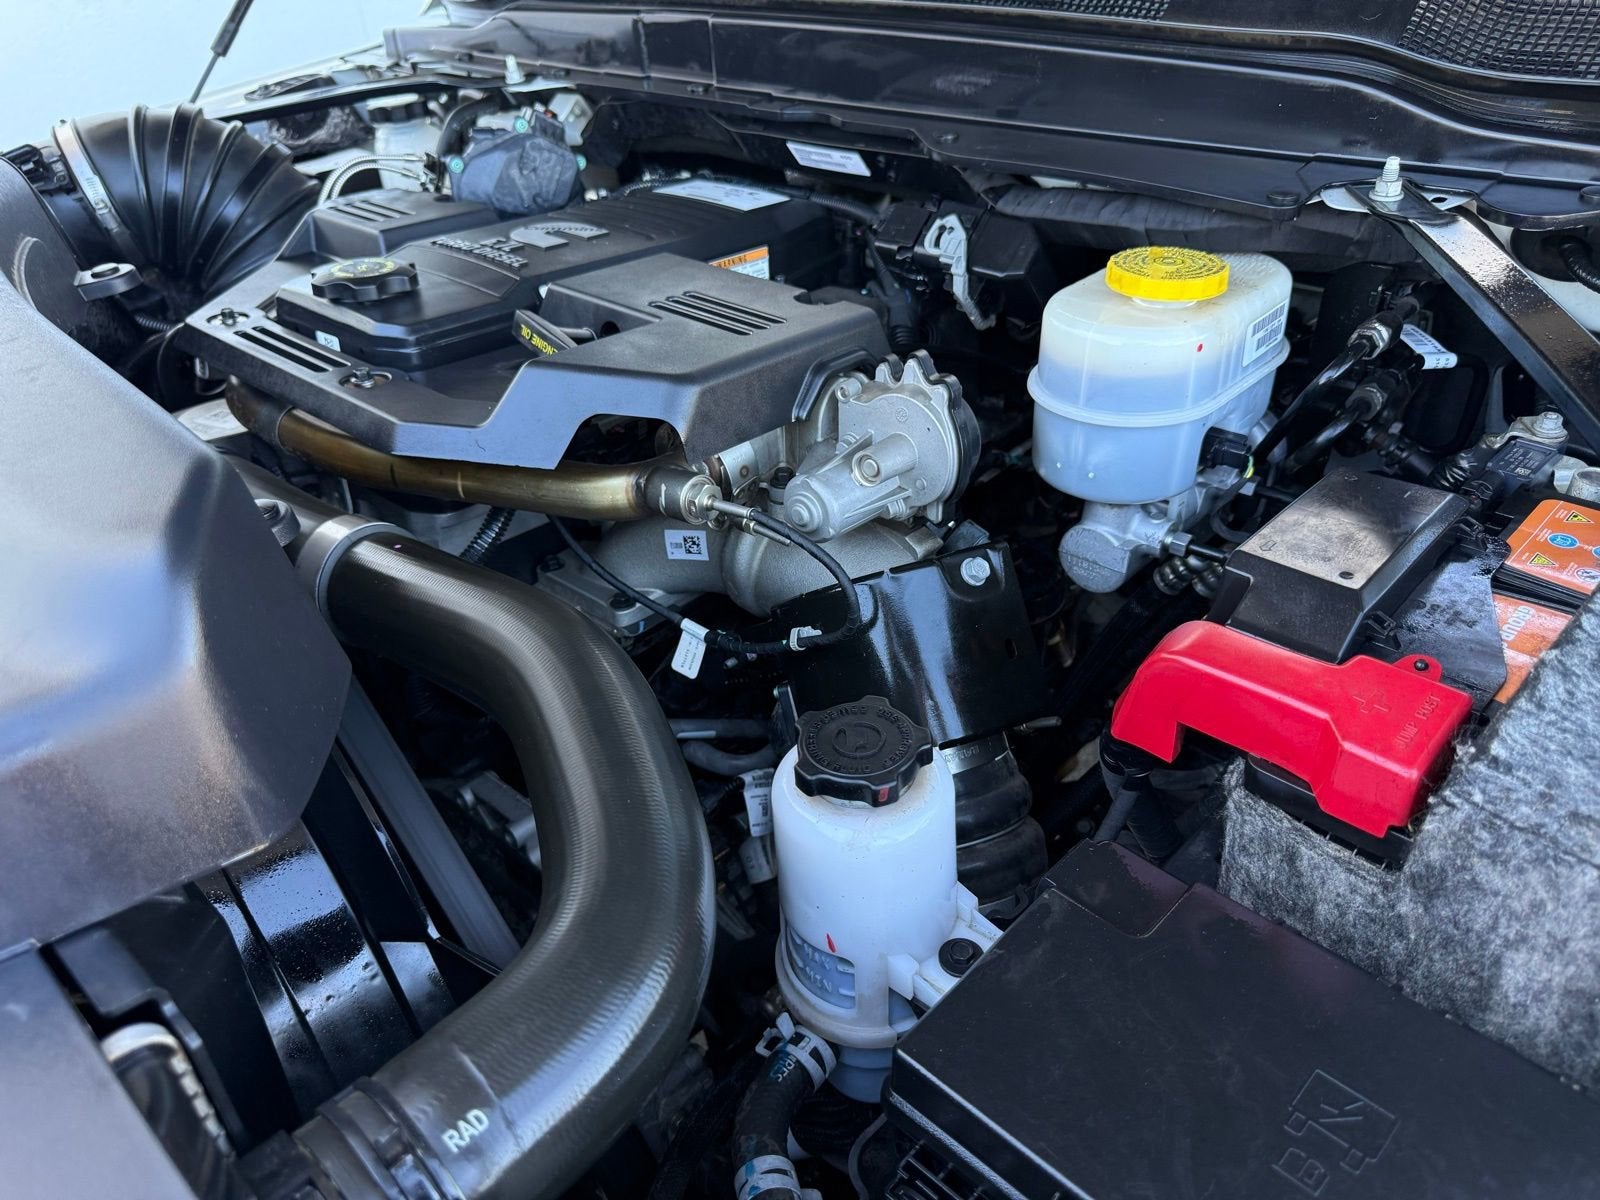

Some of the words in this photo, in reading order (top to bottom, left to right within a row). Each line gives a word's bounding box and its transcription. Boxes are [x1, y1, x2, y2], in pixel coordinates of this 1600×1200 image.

[520, 323, 532, 341] OIL
[1396, 722, 1418, 749] JUMP
[1414, 693, 1441, 720] POST
[803, 942, 830, 971] MAX
[805, 965, 832, 993] MIN
[441, 1108, 490, 1155] RAD
